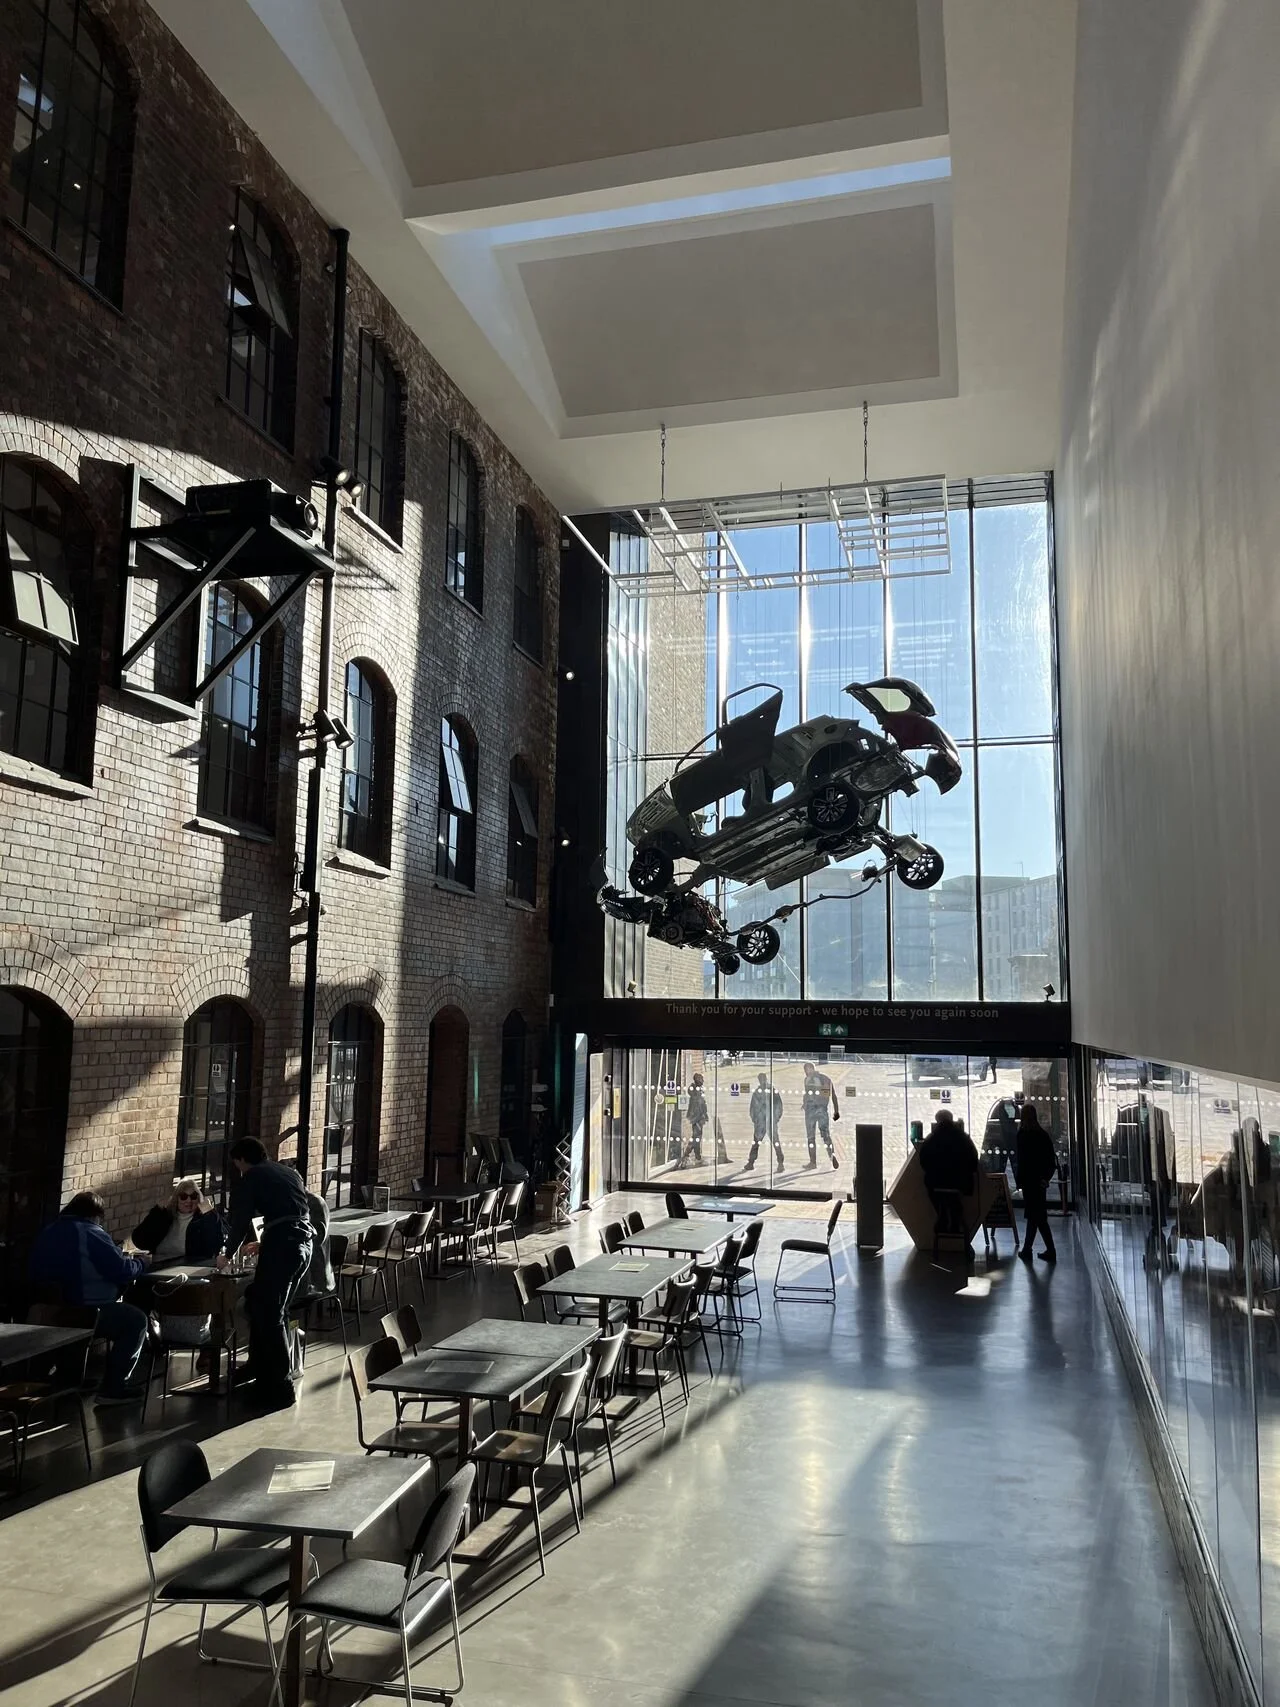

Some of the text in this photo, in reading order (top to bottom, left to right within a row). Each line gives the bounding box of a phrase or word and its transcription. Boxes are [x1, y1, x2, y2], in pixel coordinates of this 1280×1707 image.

[665, 1003, 698, 1014] Thank
[700, 1005, 720, 1016] you
[723, 1003, 739, 1014] for
[740, 1005, 765, 1017] your
[768, 1005, 811, 1018] support
[821, 1007, 837, 1016] we
[841, 1004, 869, 1018] hope
[873, 1006, 884, 1016] to
[888, 1007, 906, 1017] see
[910, 1007, 930, 1019] you
[935, 1006, 965, 1020] again
[970, 1008, 999, 1018] soon
